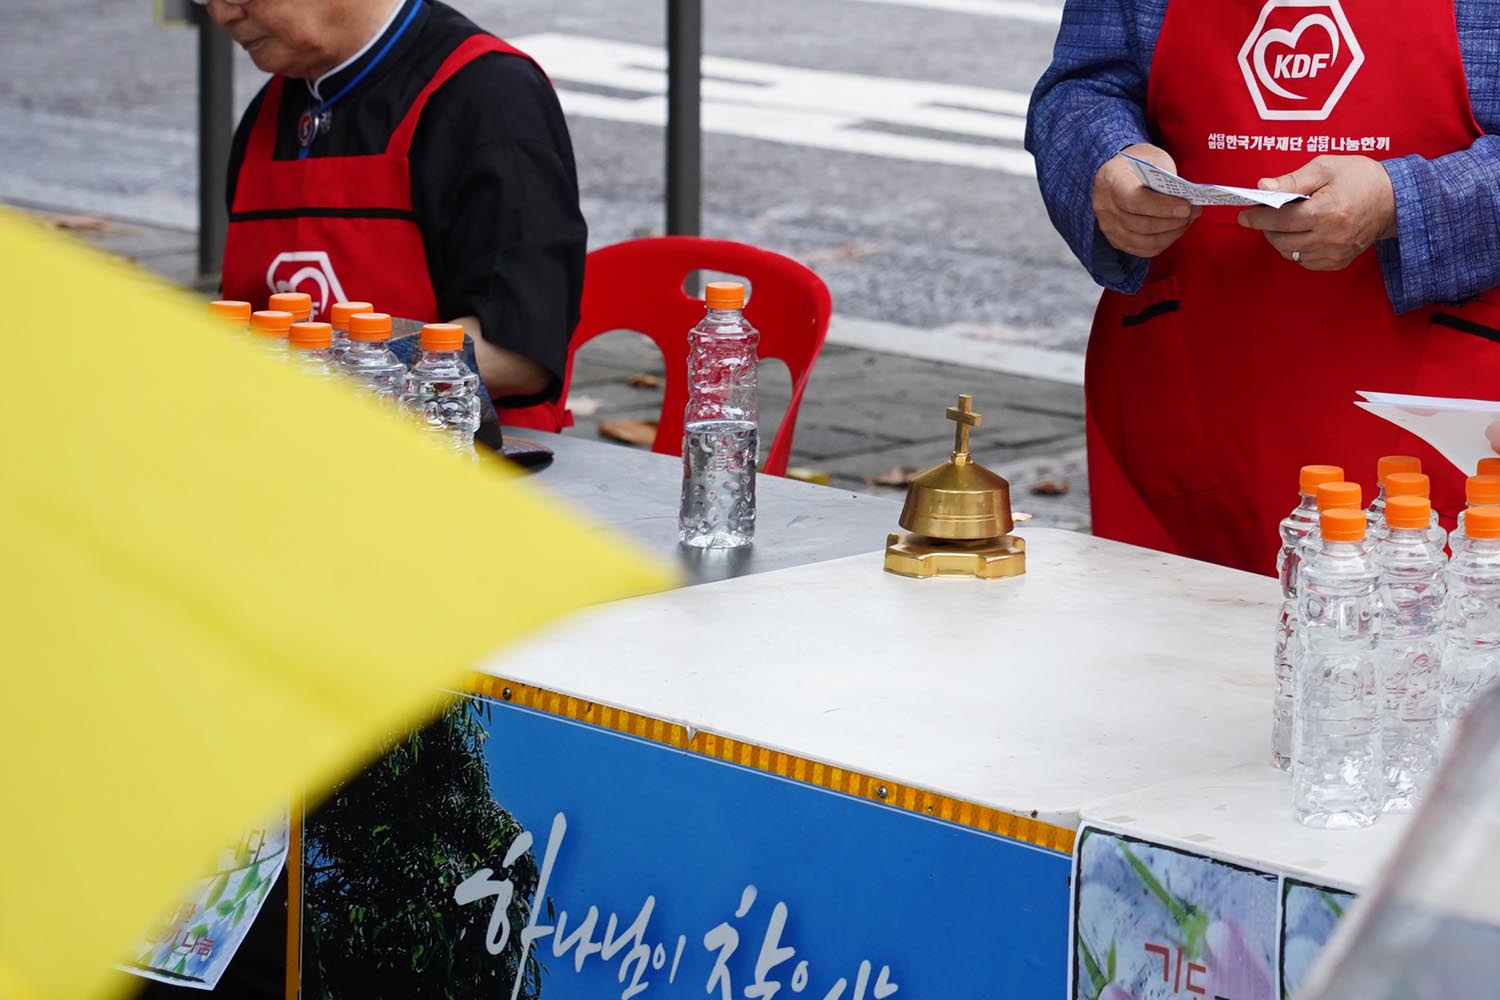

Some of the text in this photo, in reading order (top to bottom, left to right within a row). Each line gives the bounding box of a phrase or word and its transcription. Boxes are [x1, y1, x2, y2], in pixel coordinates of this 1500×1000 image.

[1273, 53, 1330, 79] KDF
[1226, 135, 1303, 151] 한국기부재단
[453, 812, 686, 1000] 하나님이
[182, 931, 216, 957] 나눔
